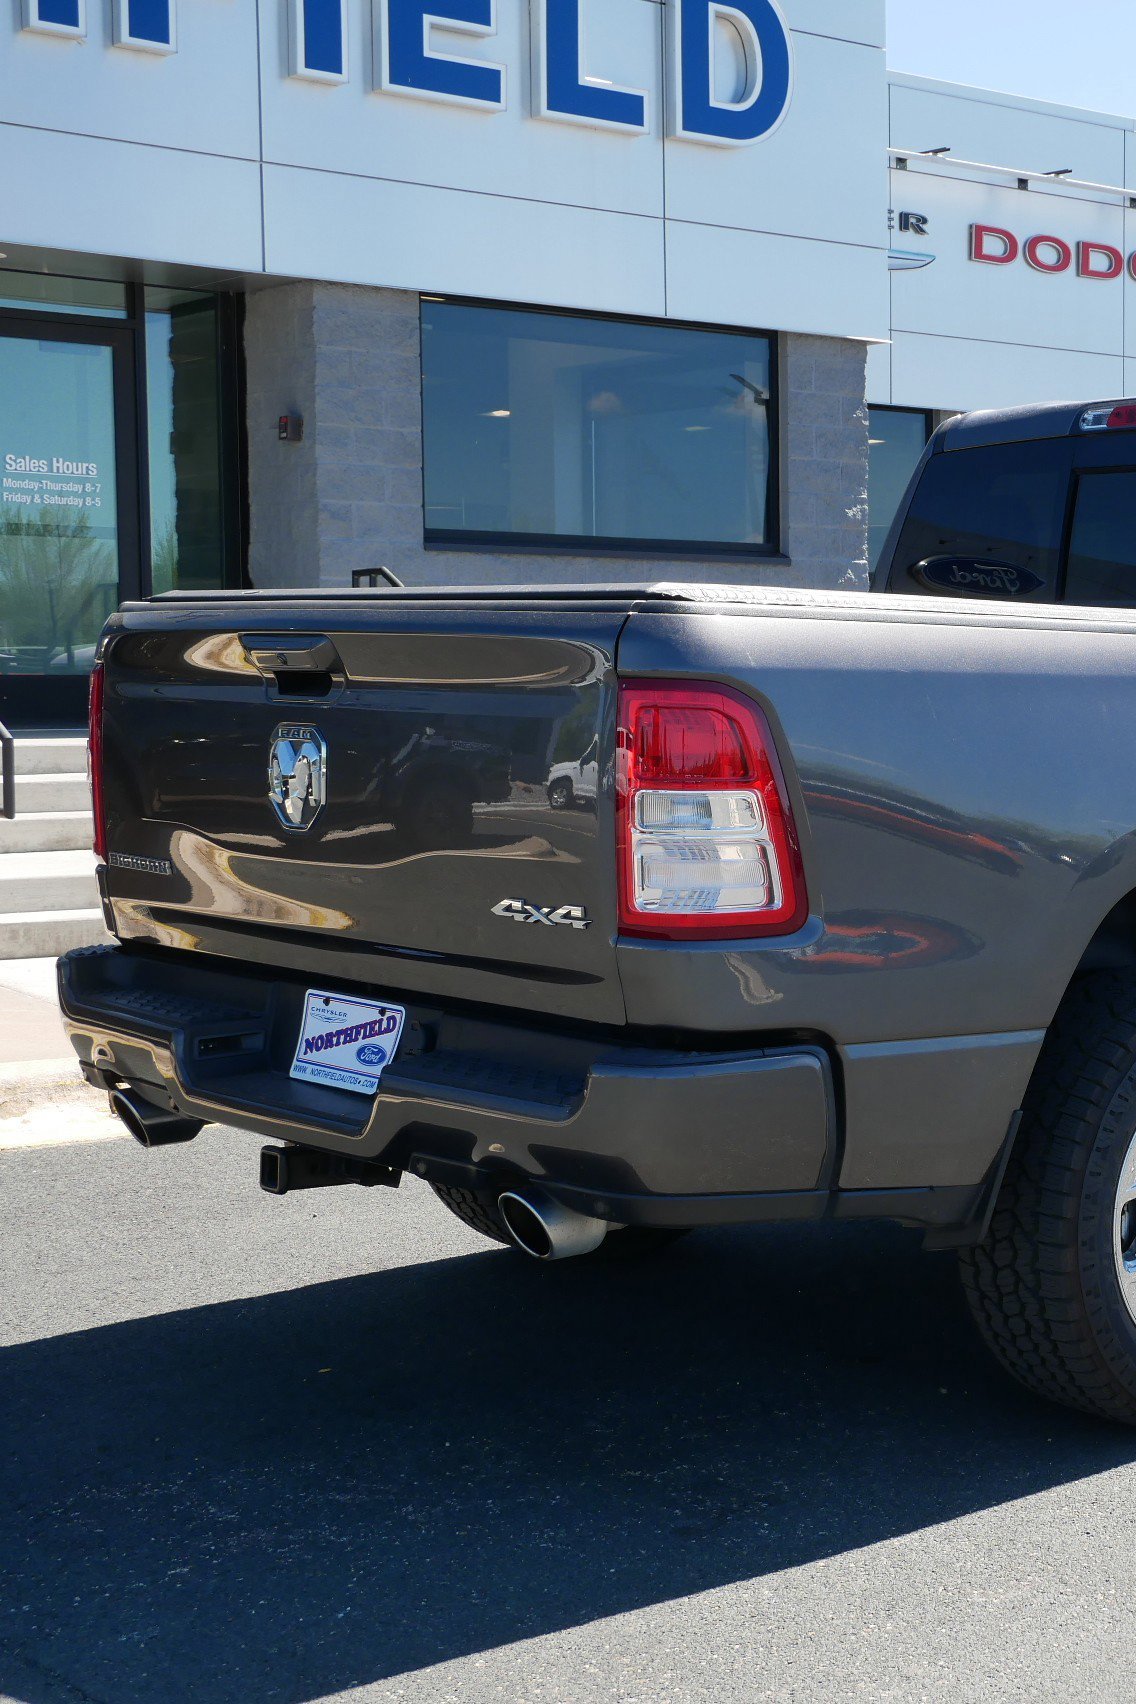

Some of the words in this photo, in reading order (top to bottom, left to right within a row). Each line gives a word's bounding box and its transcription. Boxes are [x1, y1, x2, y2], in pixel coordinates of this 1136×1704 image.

[5, 454, 48, 473] Sales
[52, 457, 97, 476] Hours
[3, 478, 83, 494] Monday-Thursday
[85, 482, 101, 493] 8-7
[3, 492, 31, 505] Friday
[33, 494, 41, 504] &
[43, 494, 83, 507] Saturday
[85, 496, 101, 507] 8-5
[278, 728, 311, 739] RAM
[311, 1006, 348, 1018] CHRYSLER
[303, 1015, 398, 1055] NORTHFIELD
[360, 1046, 382, 1063] Ford
